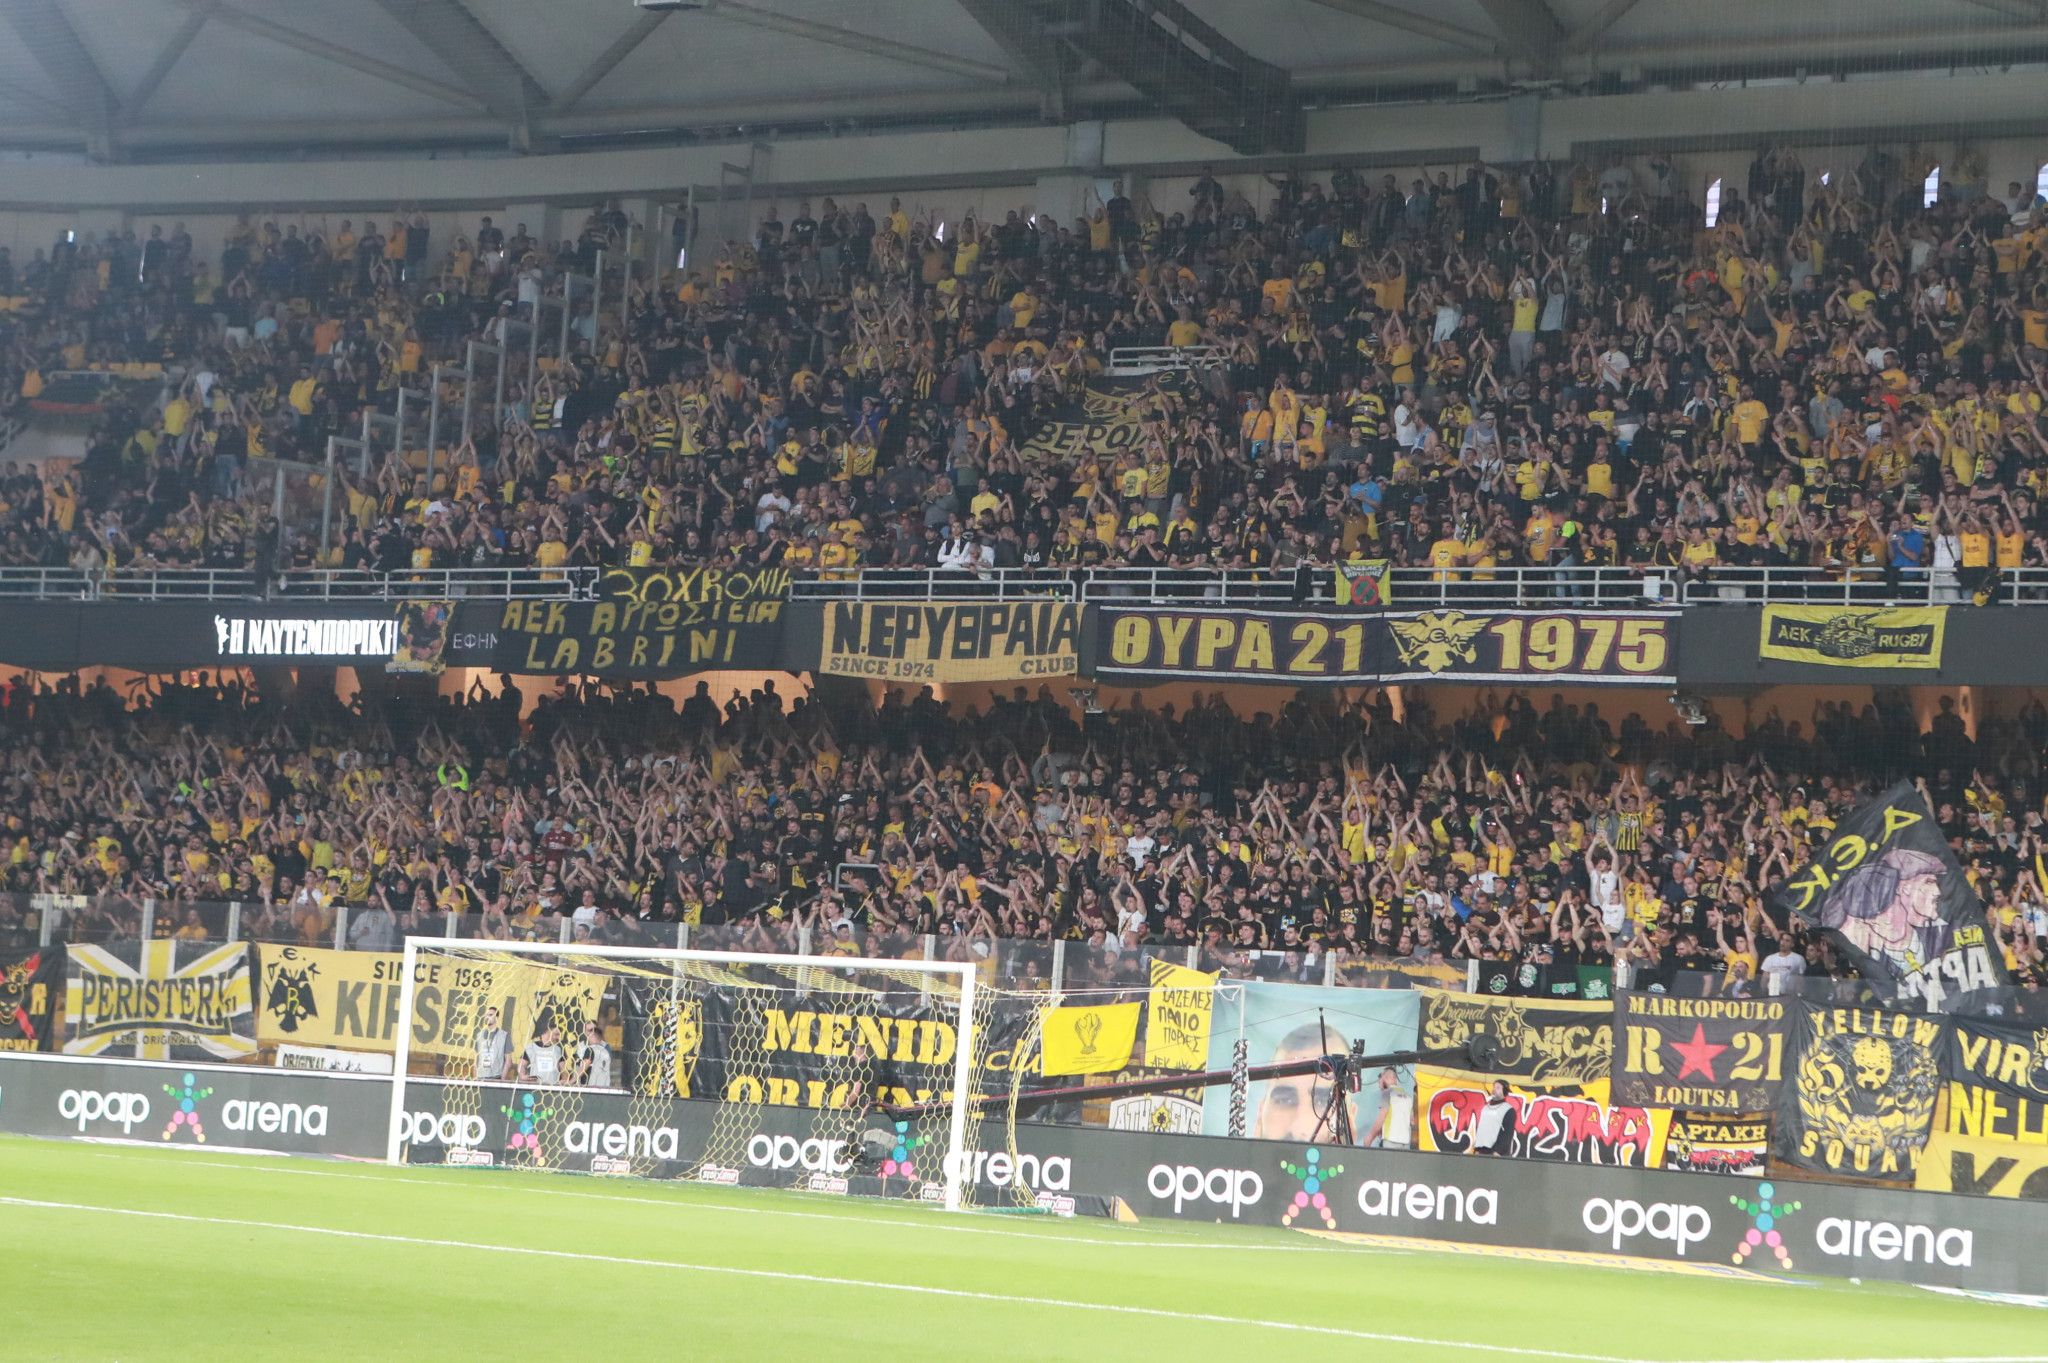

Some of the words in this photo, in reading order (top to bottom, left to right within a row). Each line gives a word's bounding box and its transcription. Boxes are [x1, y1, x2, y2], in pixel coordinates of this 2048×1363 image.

[1032, 422, 1148, 450] ΒΕΡΟΙ
[229, 619, 246, 654] Η
[525, 628, 737, 669] LABRINI
[1287, 621, 1364, 673] 21
[1489, 617, 1668, 673] 1975
[1778, 624, 1812, 643] AEK
[1878, 632, 1929, 648] RUGBY
[829, 656, 890, 675] SINCE
[893, 662, 935, 678] 1974
[1020, 656, 1076, 675] CLUB
[1628, 996, 1784, 1020] MARKOPOULO
[1809, 1009, 1940, 1048] YELLOW
[1624, 1026, 1665, 1075] R
[1729, 1032, 1784, 1081] 21
[58, 1089, 150, 1134] opap
[222, 1099, 329, 1136] arena
[1654, 1086, 1740, 1108] LOUTSA
[564, 1121, 679, 1160] arena
[1148, 1164, 1264, 1218] opap
[1358, 1179, 1499, 1225] arena
[1582, 1197, 1712, 1256] opap
[1816, 1217, 1974, 1267] arena
